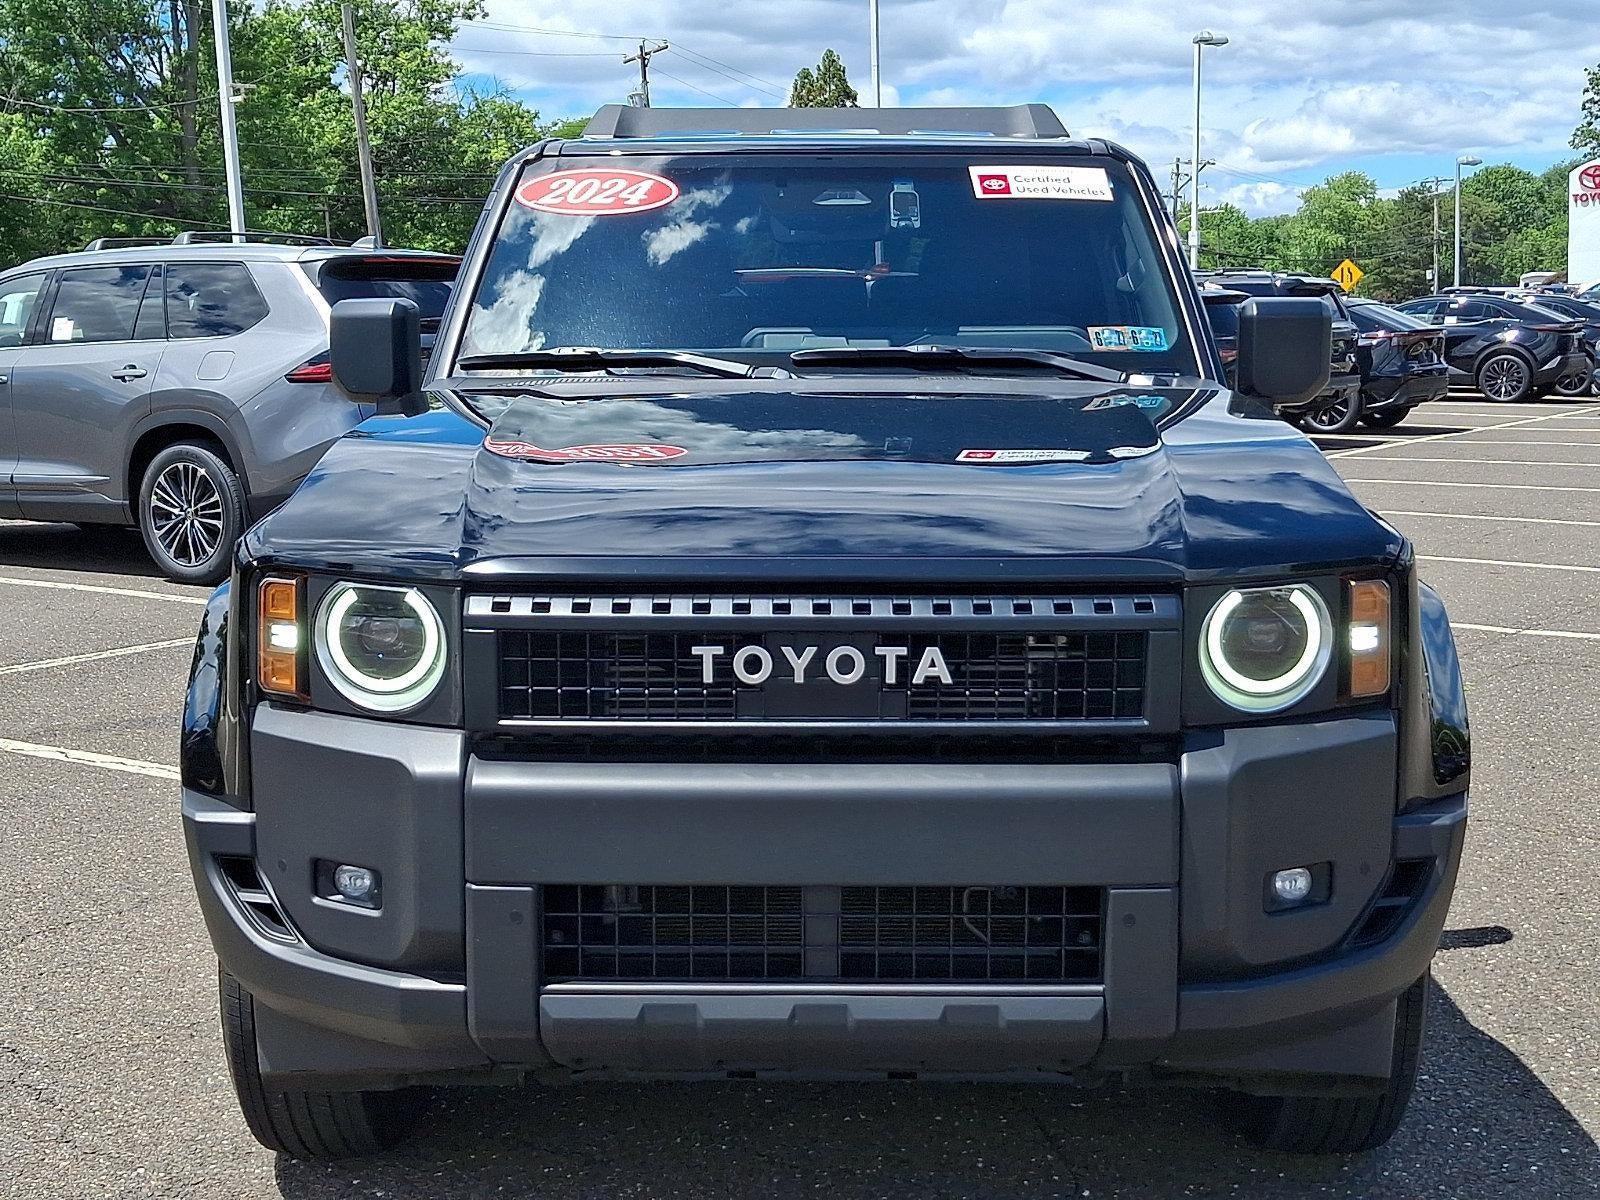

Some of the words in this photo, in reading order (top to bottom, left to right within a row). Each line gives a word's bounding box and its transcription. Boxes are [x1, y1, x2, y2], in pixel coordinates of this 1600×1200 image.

[1013, 175, 1071, 184] Certified
[536, 178, 655, 205] 2024
[1016, 186, 1049, 194] Used
[1053, 186, 1106, 196] Vehicles
[1572, 192, 1600, 203] TOY
[691, 645, 953, 685] TOYOTA
